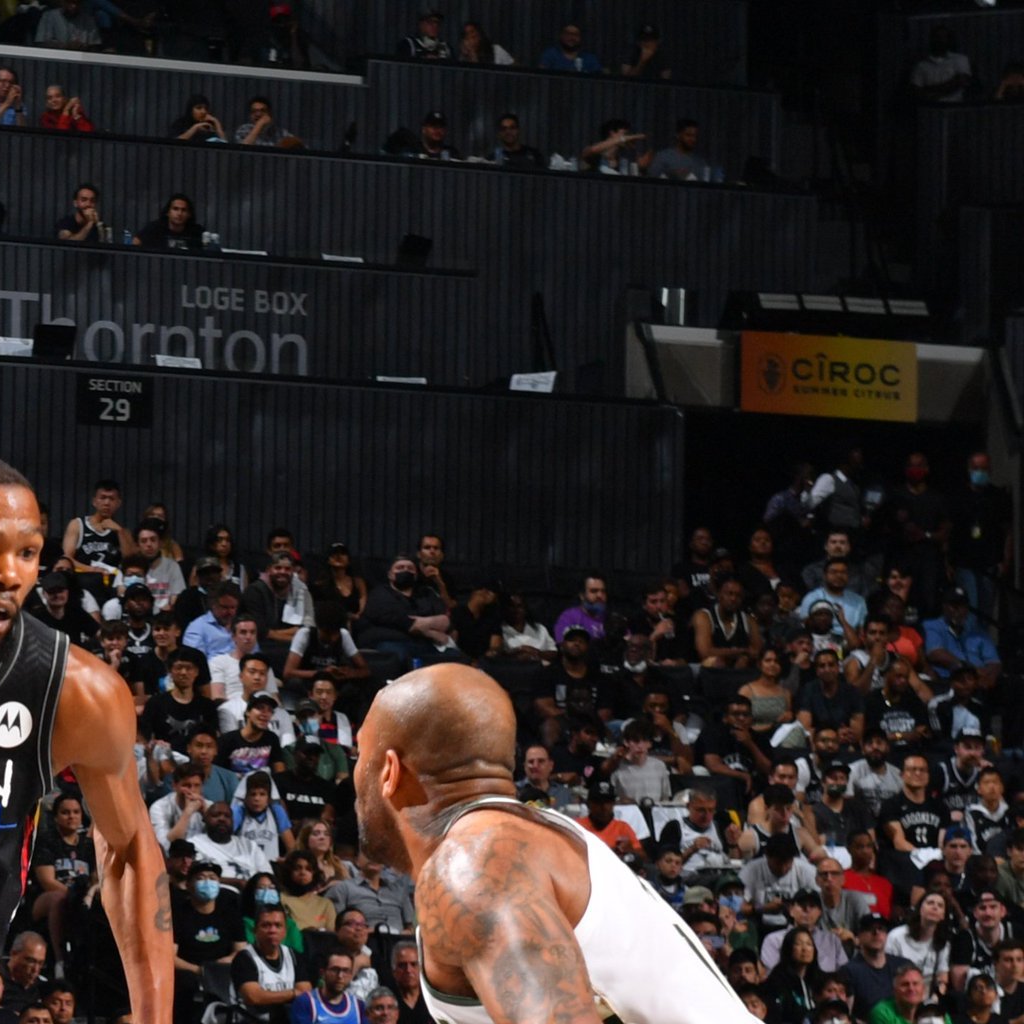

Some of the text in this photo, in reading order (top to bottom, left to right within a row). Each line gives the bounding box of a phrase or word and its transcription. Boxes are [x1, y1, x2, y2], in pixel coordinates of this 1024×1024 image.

[181, 284, 308, 317] LOGE BOX
[88, 378, 143, 394] SECTION
[99, 397, 131, 422] 29
